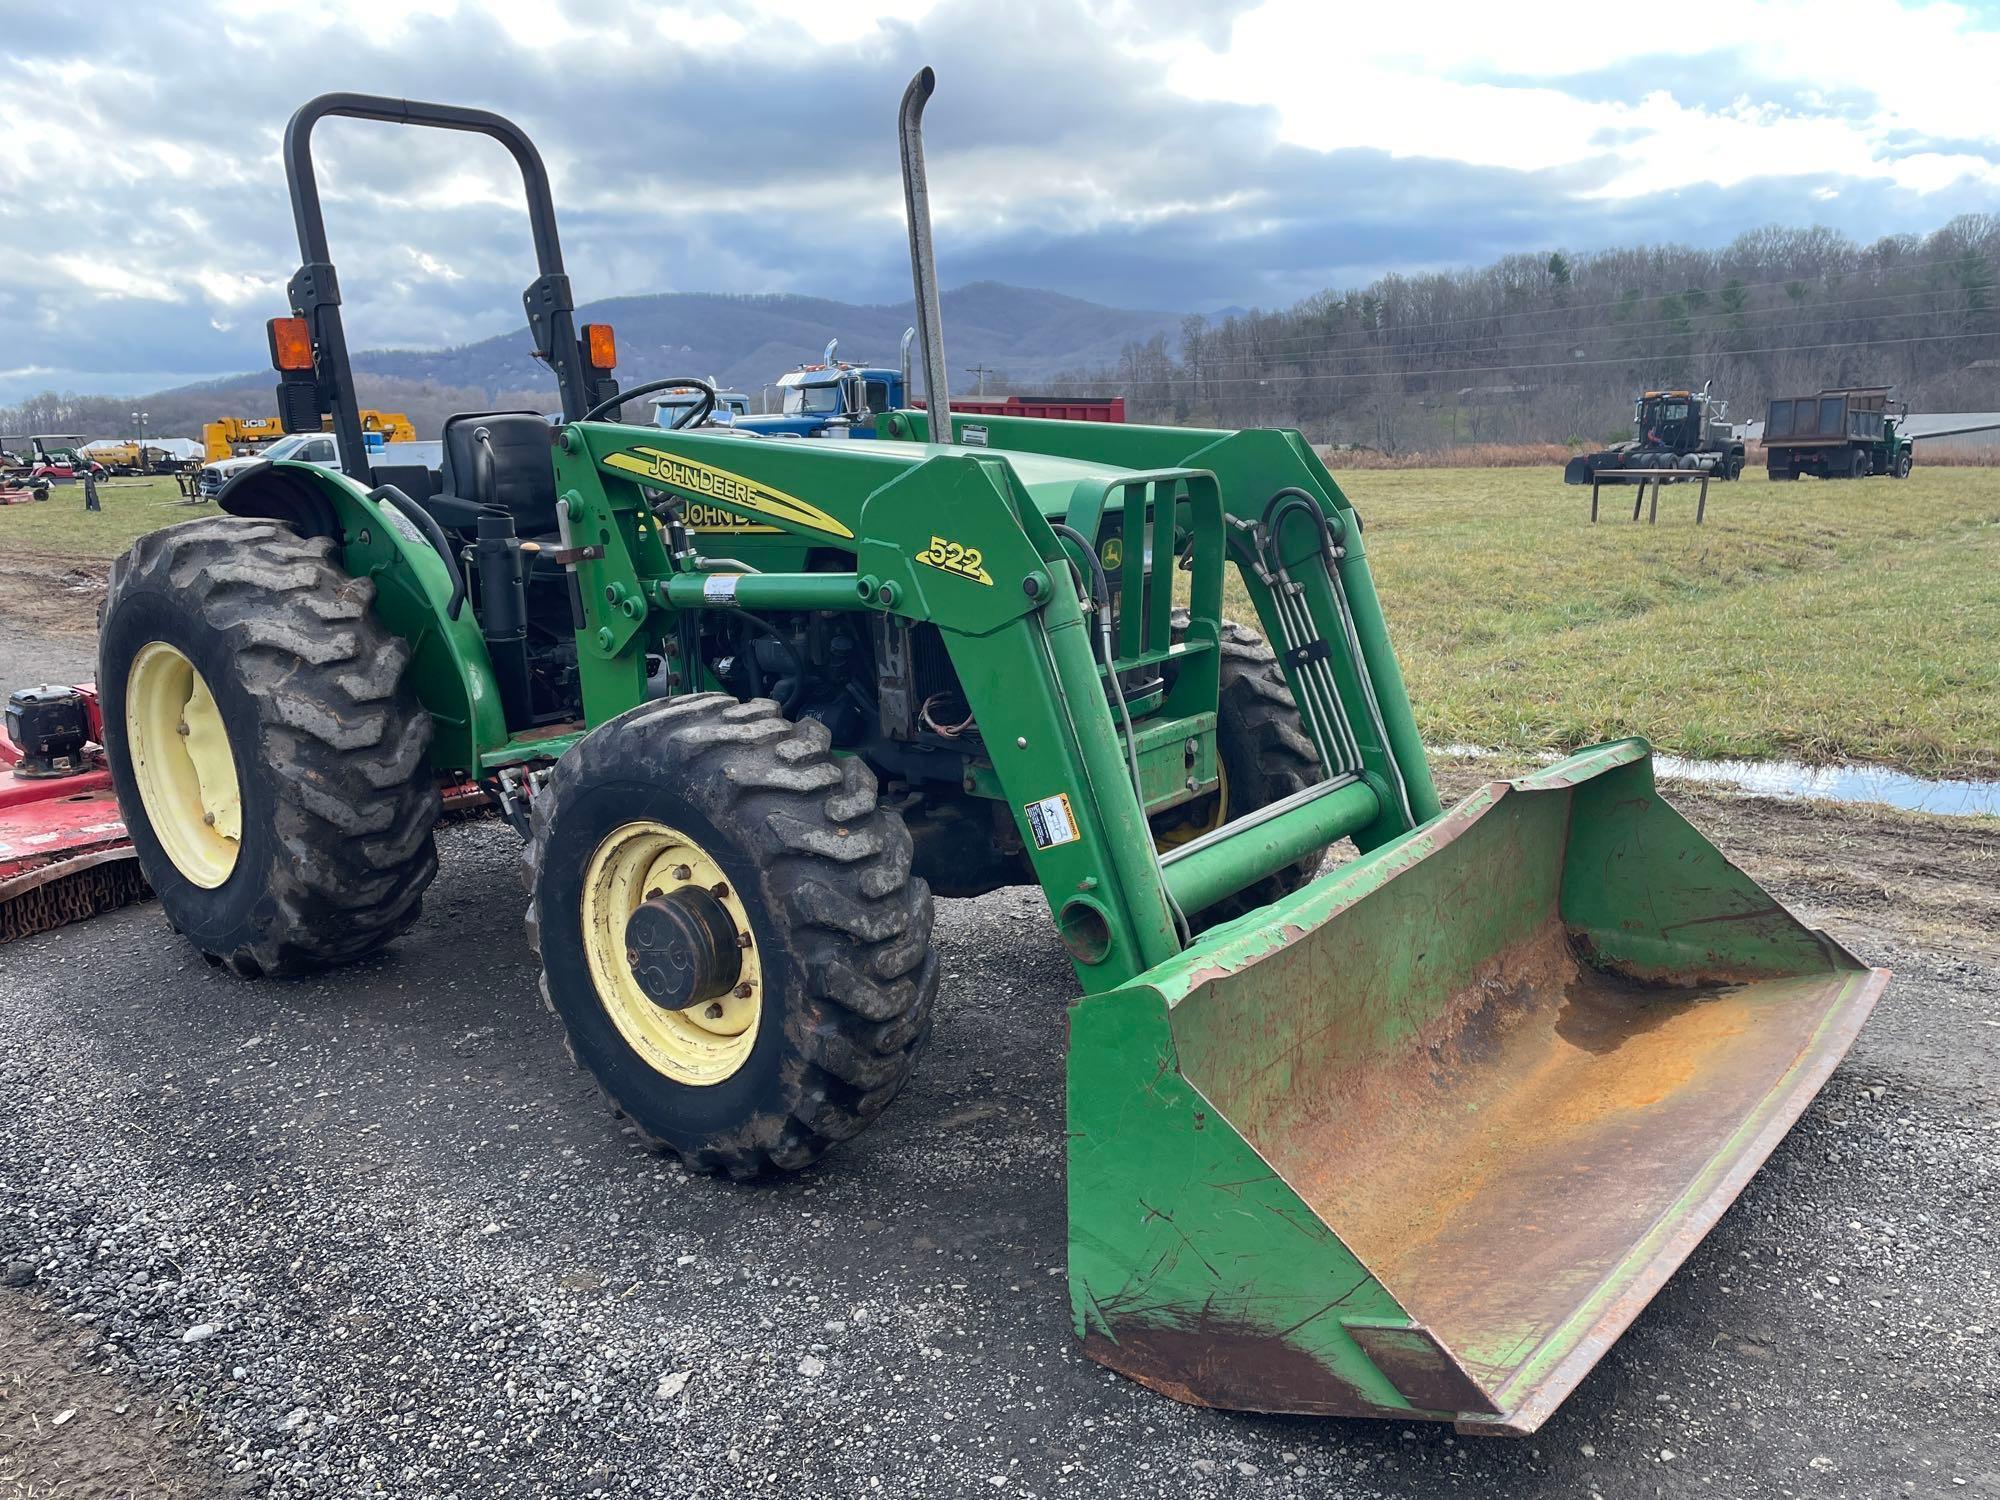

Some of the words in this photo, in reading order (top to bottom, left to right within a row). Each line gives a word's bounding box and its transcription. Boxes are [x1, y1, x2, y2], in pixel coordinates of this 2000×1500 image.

[242, 419, 267, 428] JCB
[649, 454, 698, 487] JOHN
[698, 467, 758, 505] DEERE
[679, 500, 733, 525] JOHN
[929, 535, 982, 580] 522
[1065, 806, 1078, 836] WARNING
